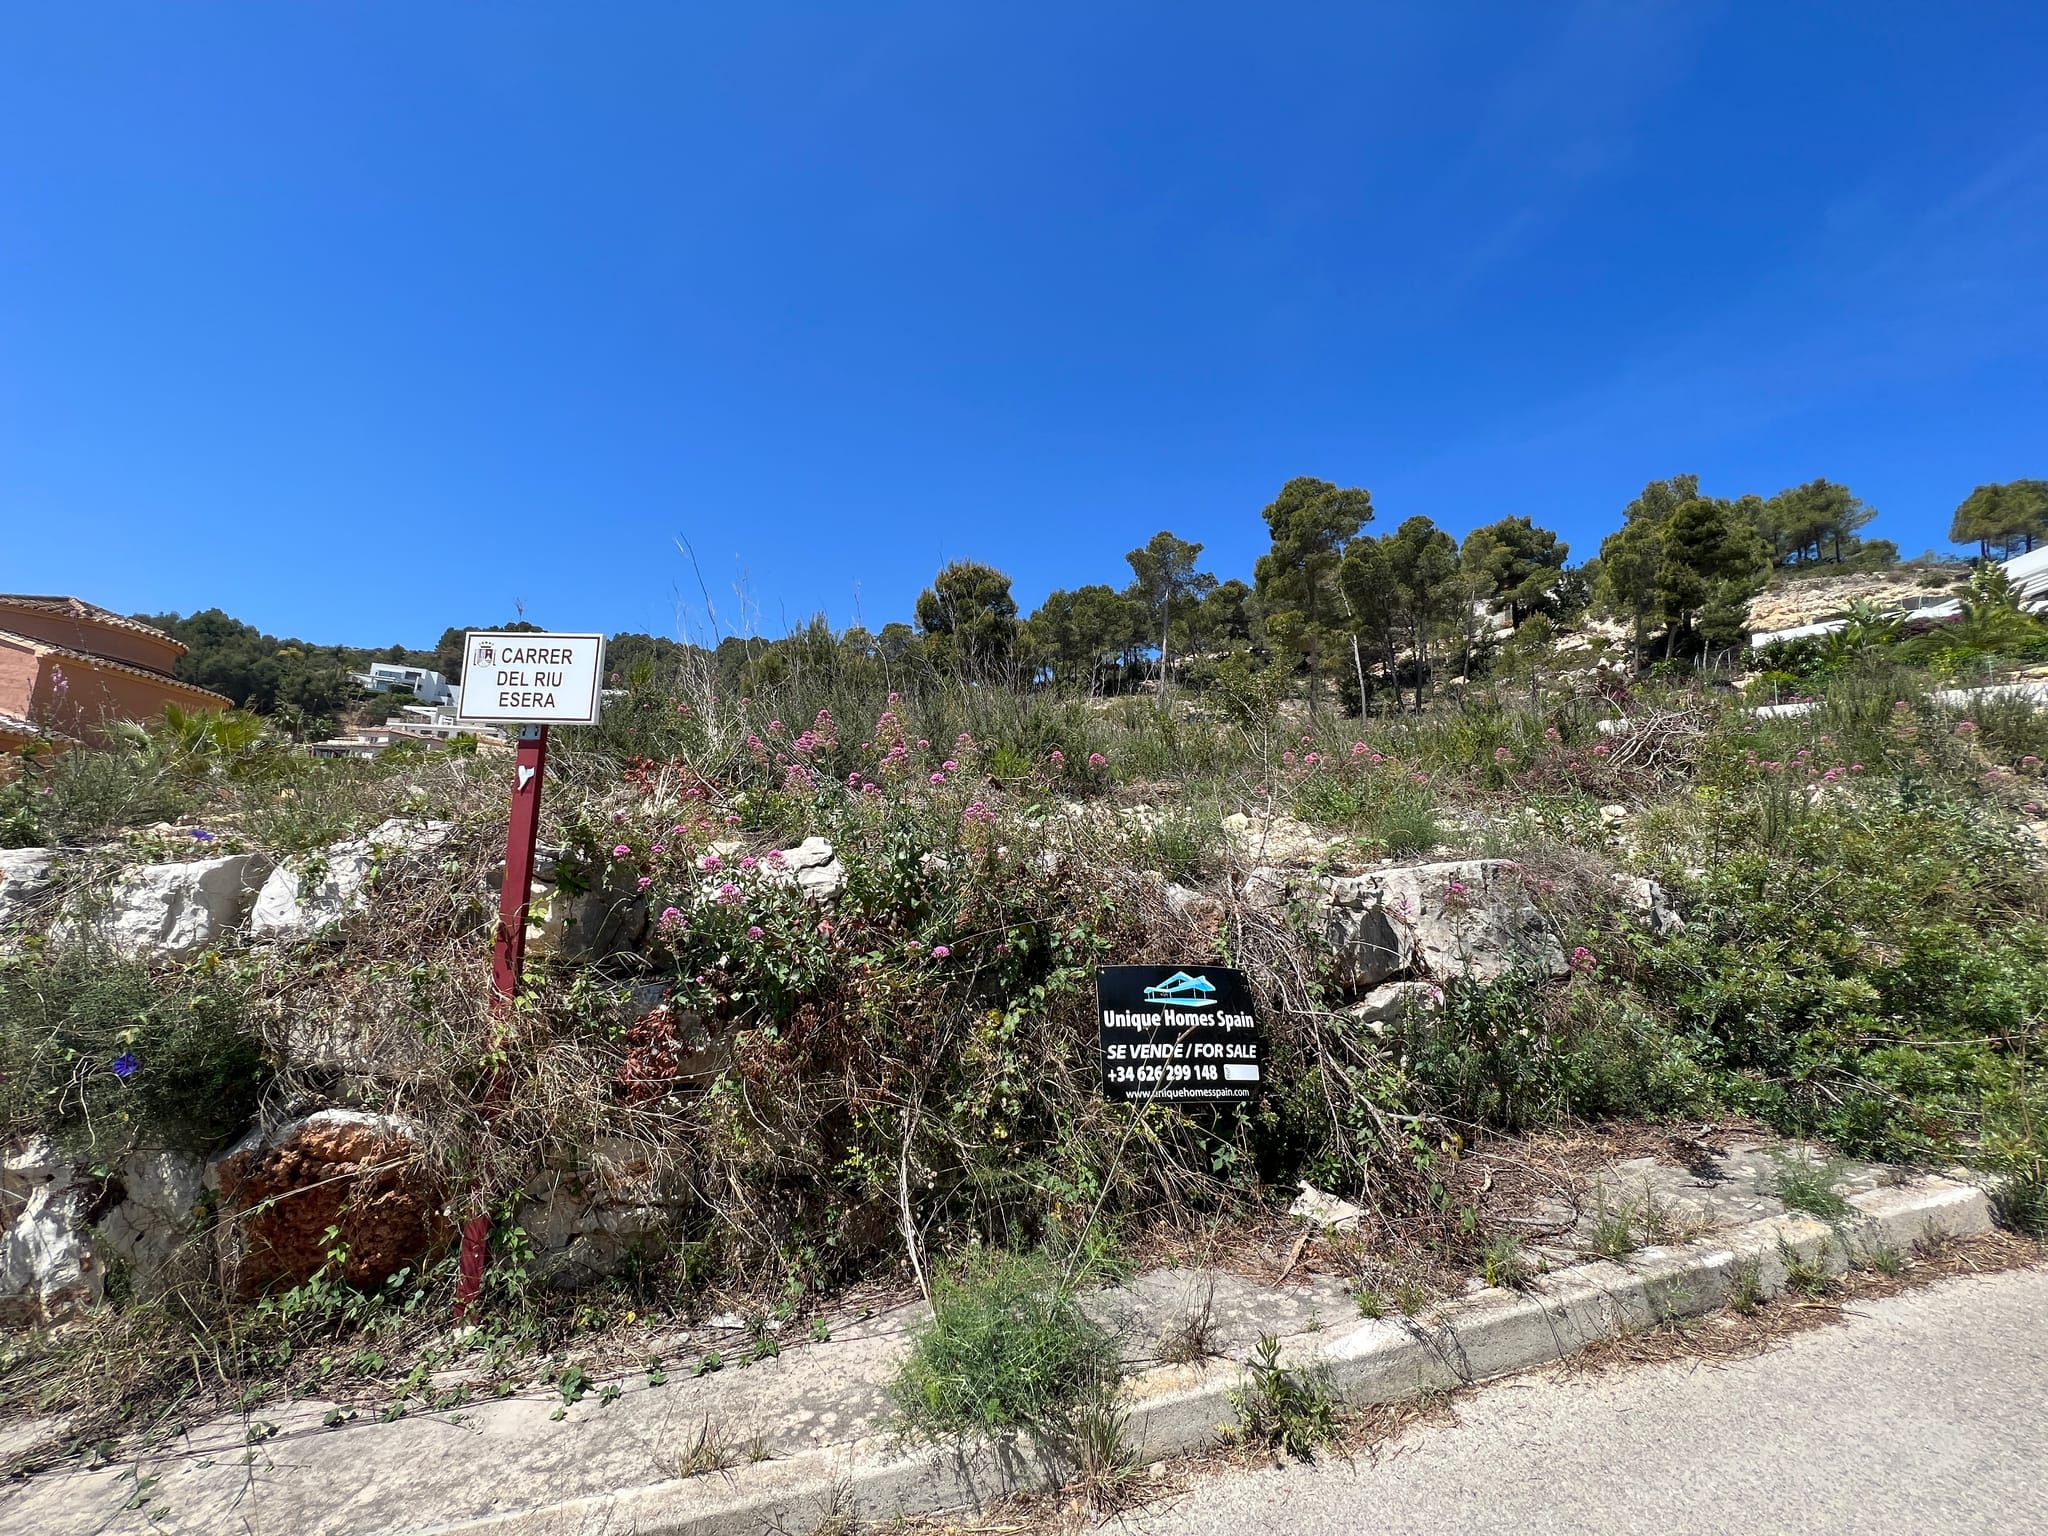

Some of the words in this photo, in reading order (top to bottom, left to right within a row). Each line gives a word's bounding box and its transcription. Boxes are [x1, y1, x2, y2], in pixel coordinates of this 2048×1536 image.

[501, 647, 573, 665] CARRER
[496, 670, 529, 687] DEL
[534, 671, 563, 687] RIU
[498, 691, 556, 708] ESERA
[1103, 1009, 1161, 1032] Unique
[1164, 1009, 1215, 1027] Homes
[1216, 1010, 1254, 1032] Spain
[1107, 1044, 1127, 1059] SE
[1129, 1043, 1184, 1059] VENDE
[1186, 1044, 1193, 1059] /
[1194, 1044, 1224, 1058] FOR
[1225, 1044, 1257, 1059] SALE
[1107, 1065, 1135, 1082] +34
[1137, 1065, 1163, 1081] 626
[1165, 1065, 1192, 1081] 299
[1193, 1064, 1218, 1081] 148
[1125, 1087, 1250, 1100] wwwuniquehomesspain.com
